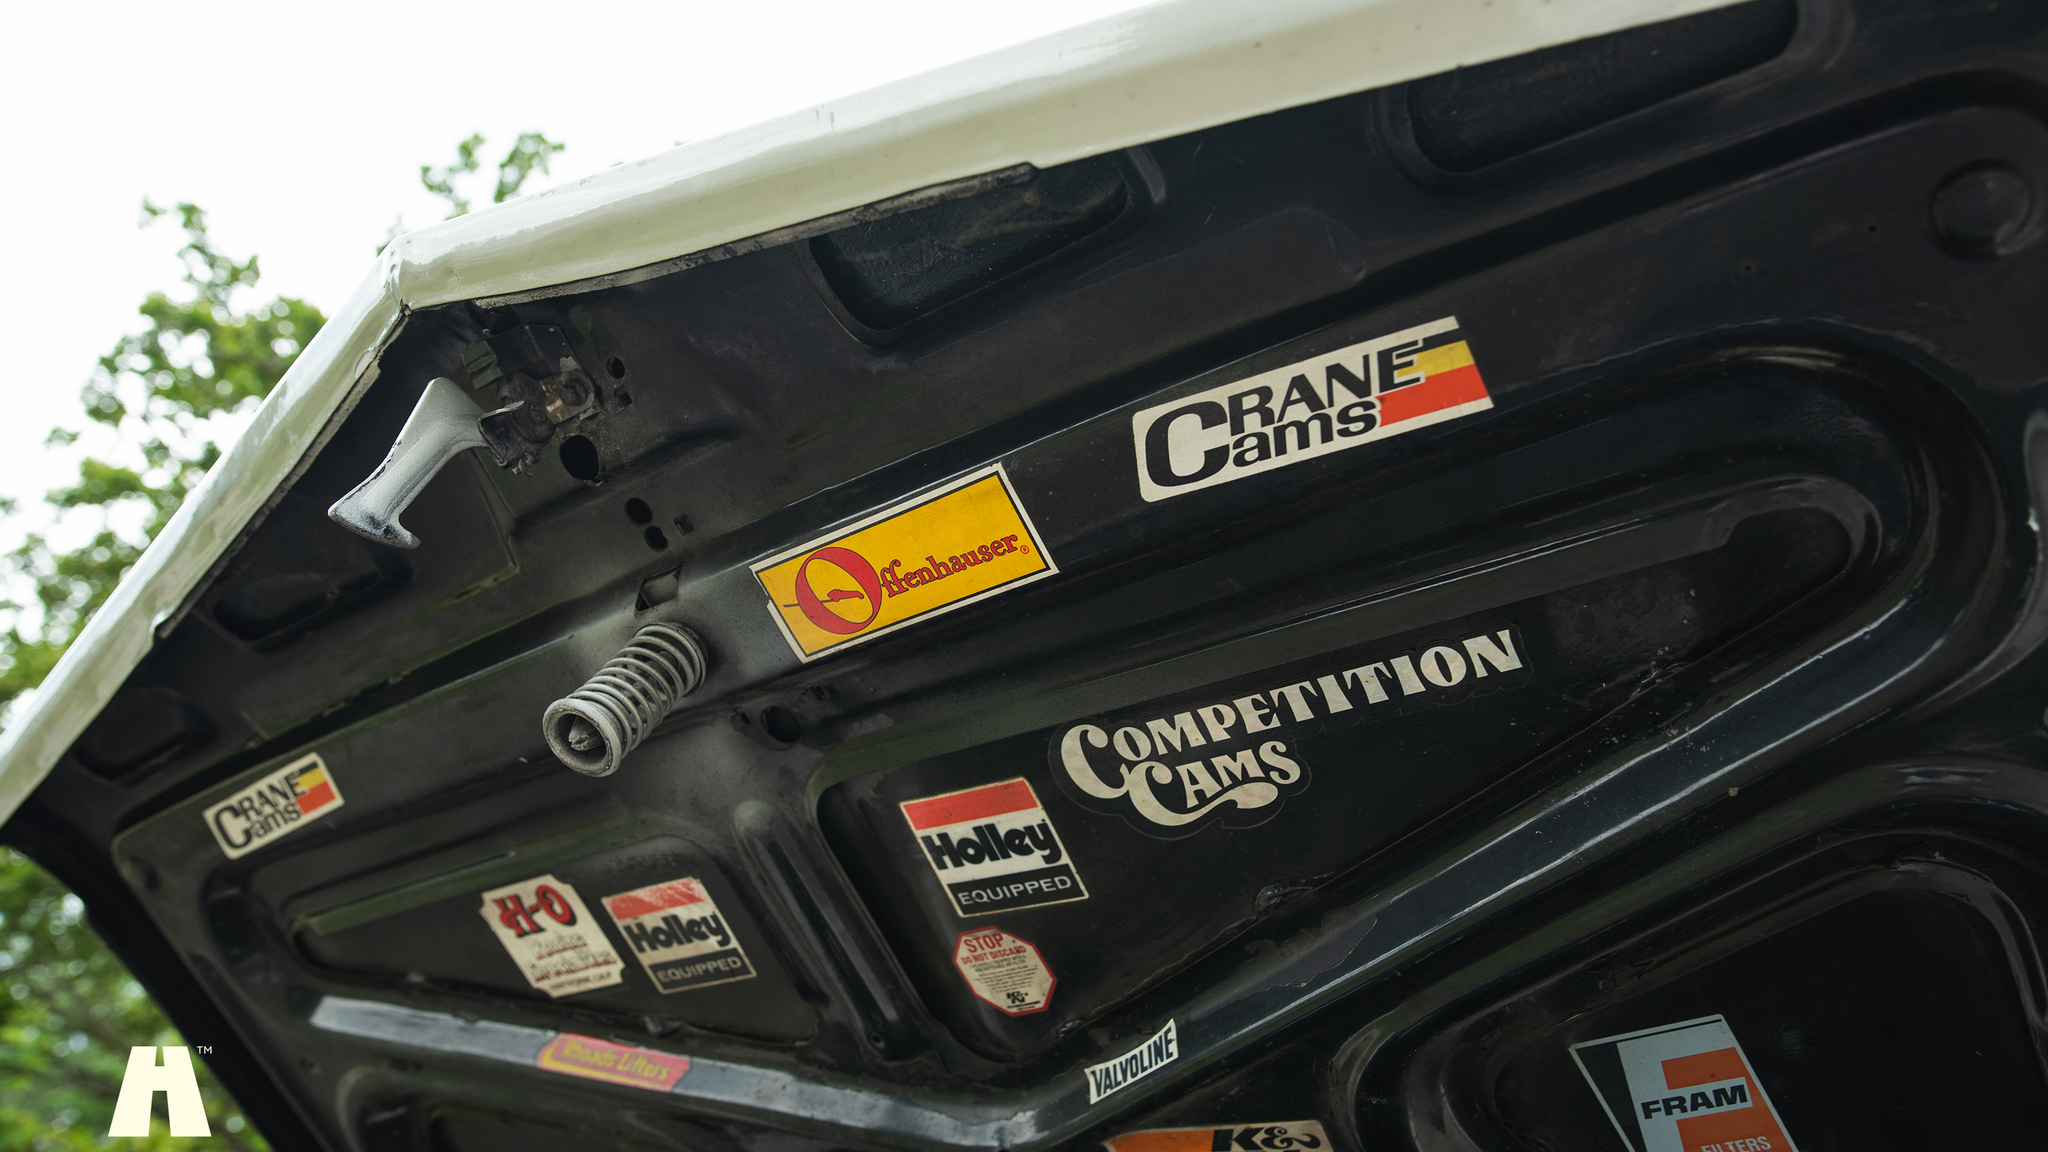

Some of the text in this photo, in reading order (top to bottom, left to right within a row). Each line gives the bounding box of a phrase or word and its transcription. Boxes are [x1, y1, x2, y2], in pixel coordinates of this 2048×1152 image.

[1146, 338, 1425, 487] CRANE
[1061, 629, 1523, 799] COMPETITION
[1128, 741, 1301, 826] CAMS
[214, 770, 309, 849] CRANE
[921, 821, 1062, 870] Holley
[493, 884, 577, 938] H-O
[957, 875, 1072, 905] EQUIPPED
[623, 911, 732, 954] Holley
[960, 956, 973, 965] DO
[972, 953, 989, 962] NOT
[989, 945, 1027, 959] DISCARD
[963, 932, 1004, 953] STOP
[656, 956, 742, 983] EQUIPPED
[1090, 1026, 1175, 1098] VALVOLINE
[1641, 1084, 1748, 1120] FRAM
